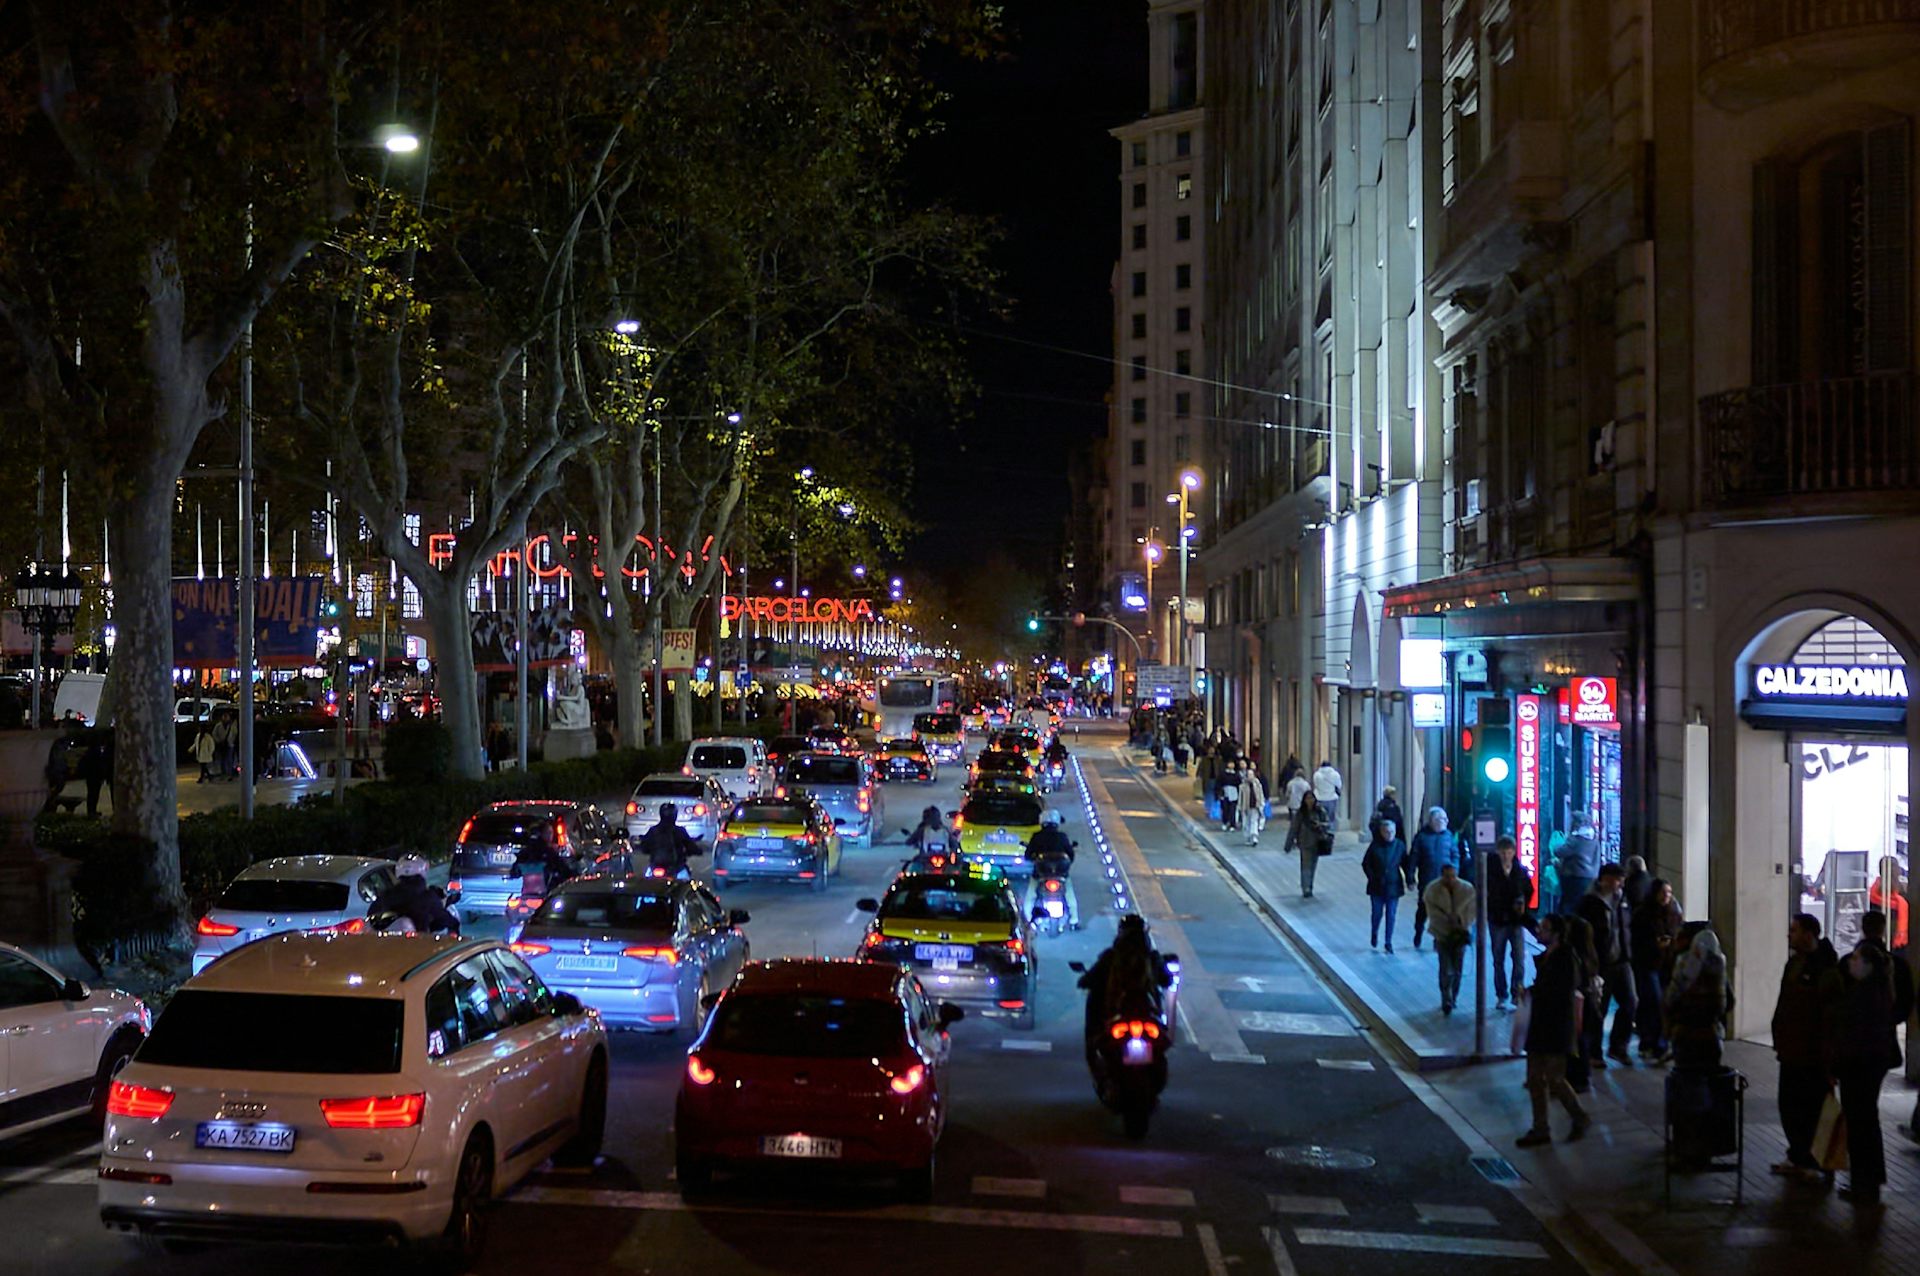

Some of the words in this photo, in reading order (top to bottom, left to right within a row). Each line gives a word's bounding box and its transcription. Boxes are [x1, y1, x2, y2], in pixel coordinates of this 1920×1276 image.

[722, 596, 874, 622] BARCELONA
[1757, 667, 1908, 697] CALZEDONIA
[1574, 712, 1614, 721] MARKET
[1520, 724, 1535, 803] SUPER
[1519, 808, 1535, 878] MARK
[206, 1128, 227, 1144] KA
[232, 1130, 266, 1146] 7527
[269, 1130, 290, 1147] BK
[768, 1139, 804, 1153] 3446
[809, 1140, 838, 1155] HTK
